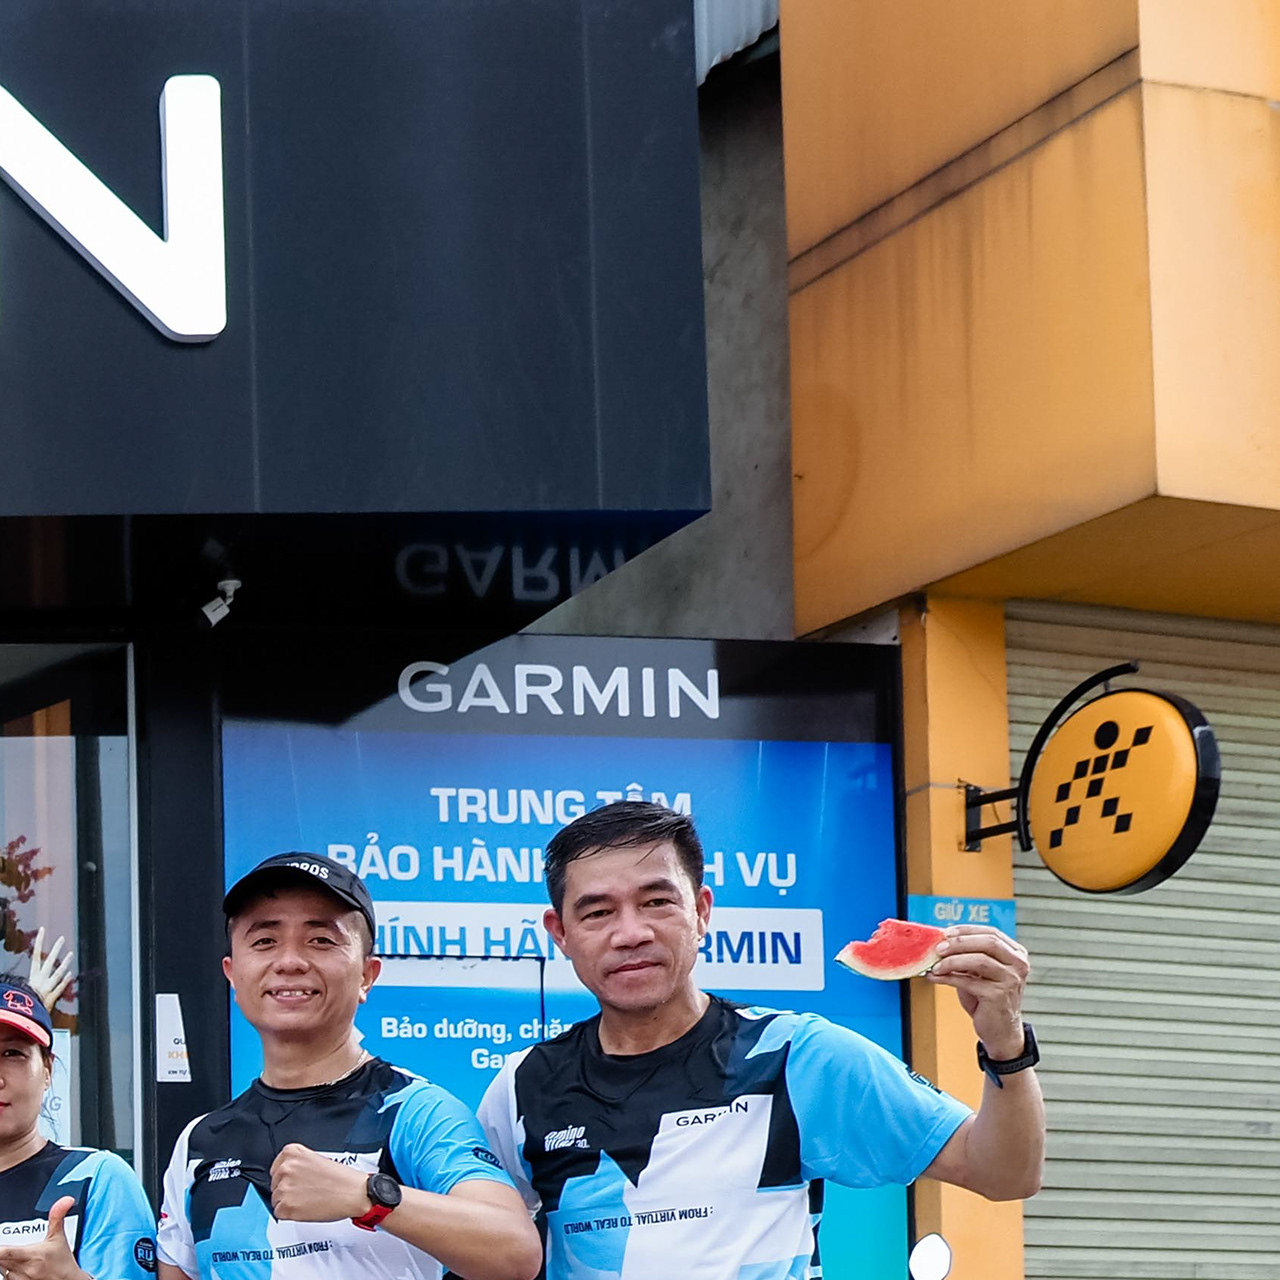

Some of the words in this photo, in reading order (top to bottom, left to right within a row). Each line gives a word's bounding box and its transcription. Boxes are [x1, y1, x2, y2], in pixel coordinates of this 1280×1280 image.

[397, 661, 719, 719] GARMIN
[431, 787, 583, 824] TRUNG
[327, 833, 420, 881] BẢO
[737, 853, 797, 896] VỤ
[968, 904, 989, 922] XE
[381, 1016, 427, 1038] Bảo
[434, 1018, 513, 1044] dưỡng,
[635, 1209, 677, 1225] VIRTUAL
[678, 1206, 708, 1219] FROM
[564, 1220, 593, 1235] WORLD
[594, 1218, 618, 1230] REAL
[620, 1216, 633, 1227] TO
